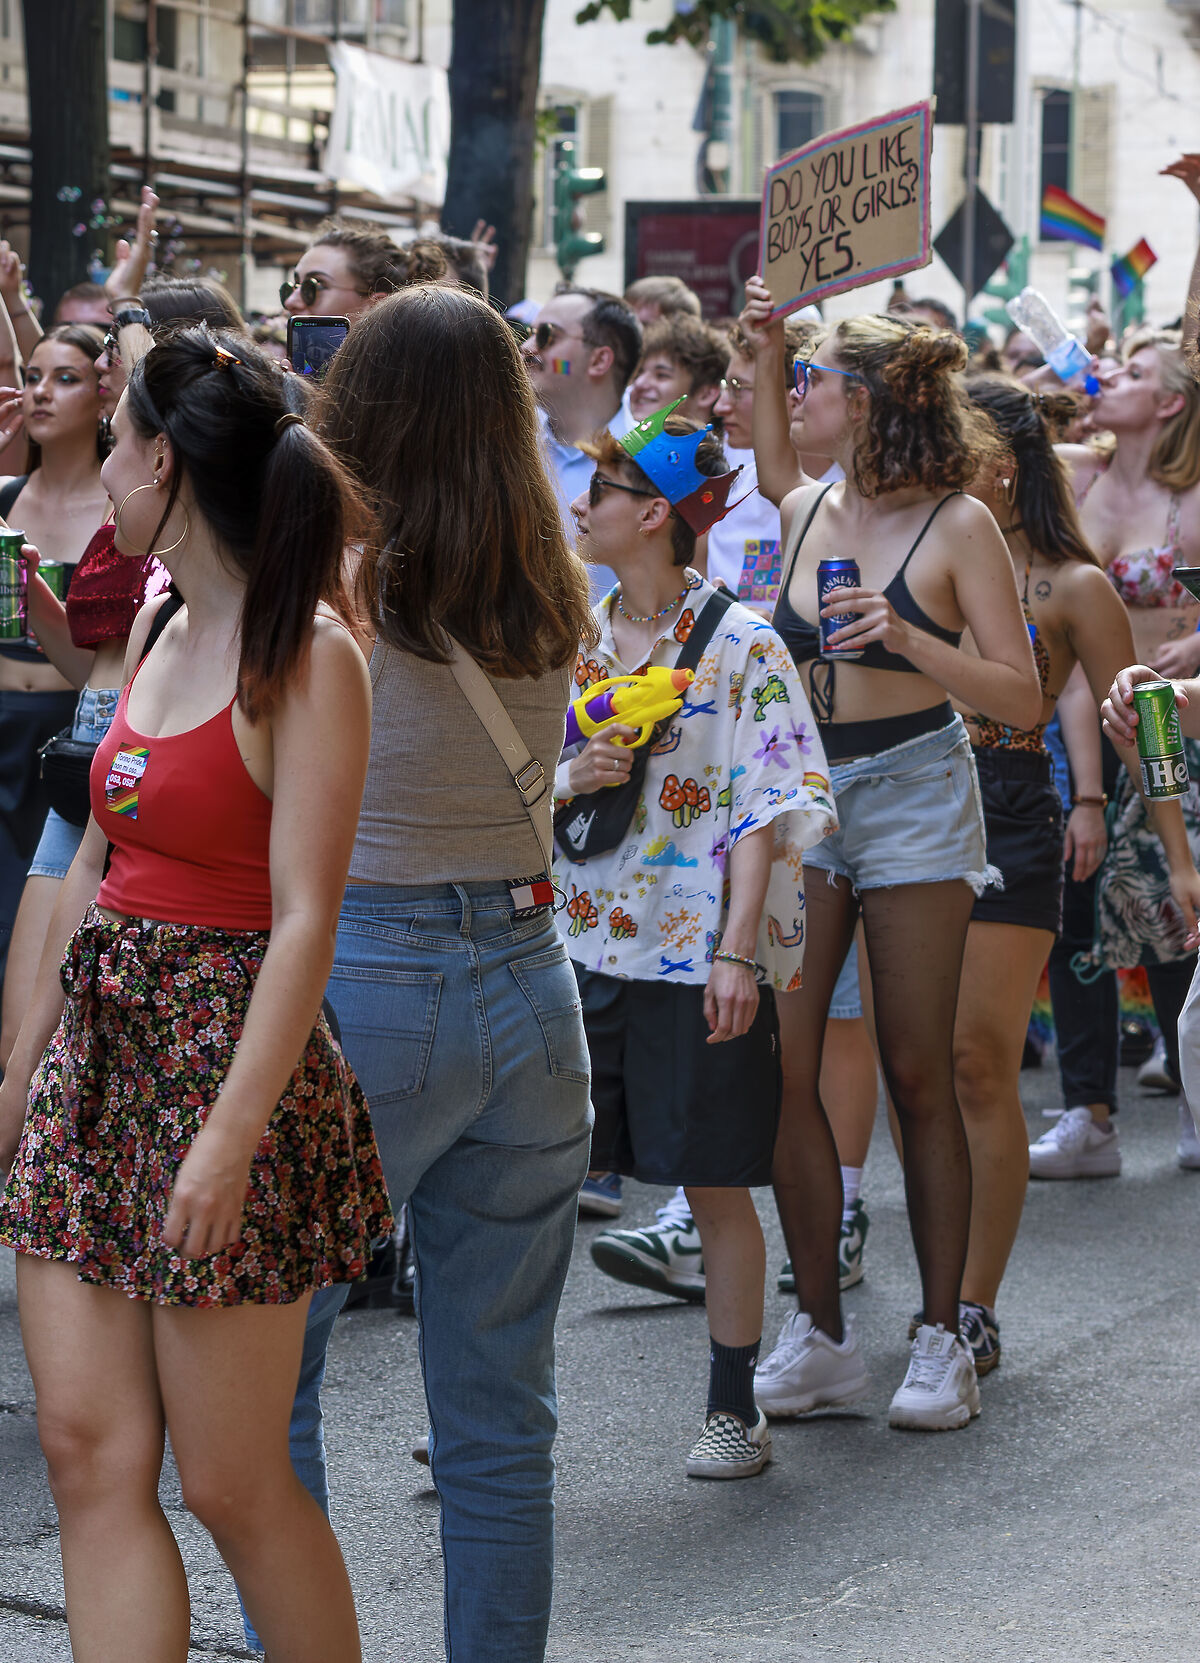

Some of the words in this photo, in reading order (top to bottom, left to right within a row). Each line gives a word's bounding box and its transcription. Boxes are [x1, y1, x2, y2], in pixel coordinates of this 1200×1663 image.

[770, 170, 803, 219] DO
[811, 146, 855, 198] YOU
[863, 126, 914, 180] LIKE
[768, 205, 813, 264] BOYS
[819, 195, 846, 235] OR
[852, 162, 919, 224] GIRLS?
[800, 230, 862, 292] YES.
[118, 752, 131, 763] Torino
[122, 776, 137, 788] osa!
[566, 812, 586, 842] NIKE
